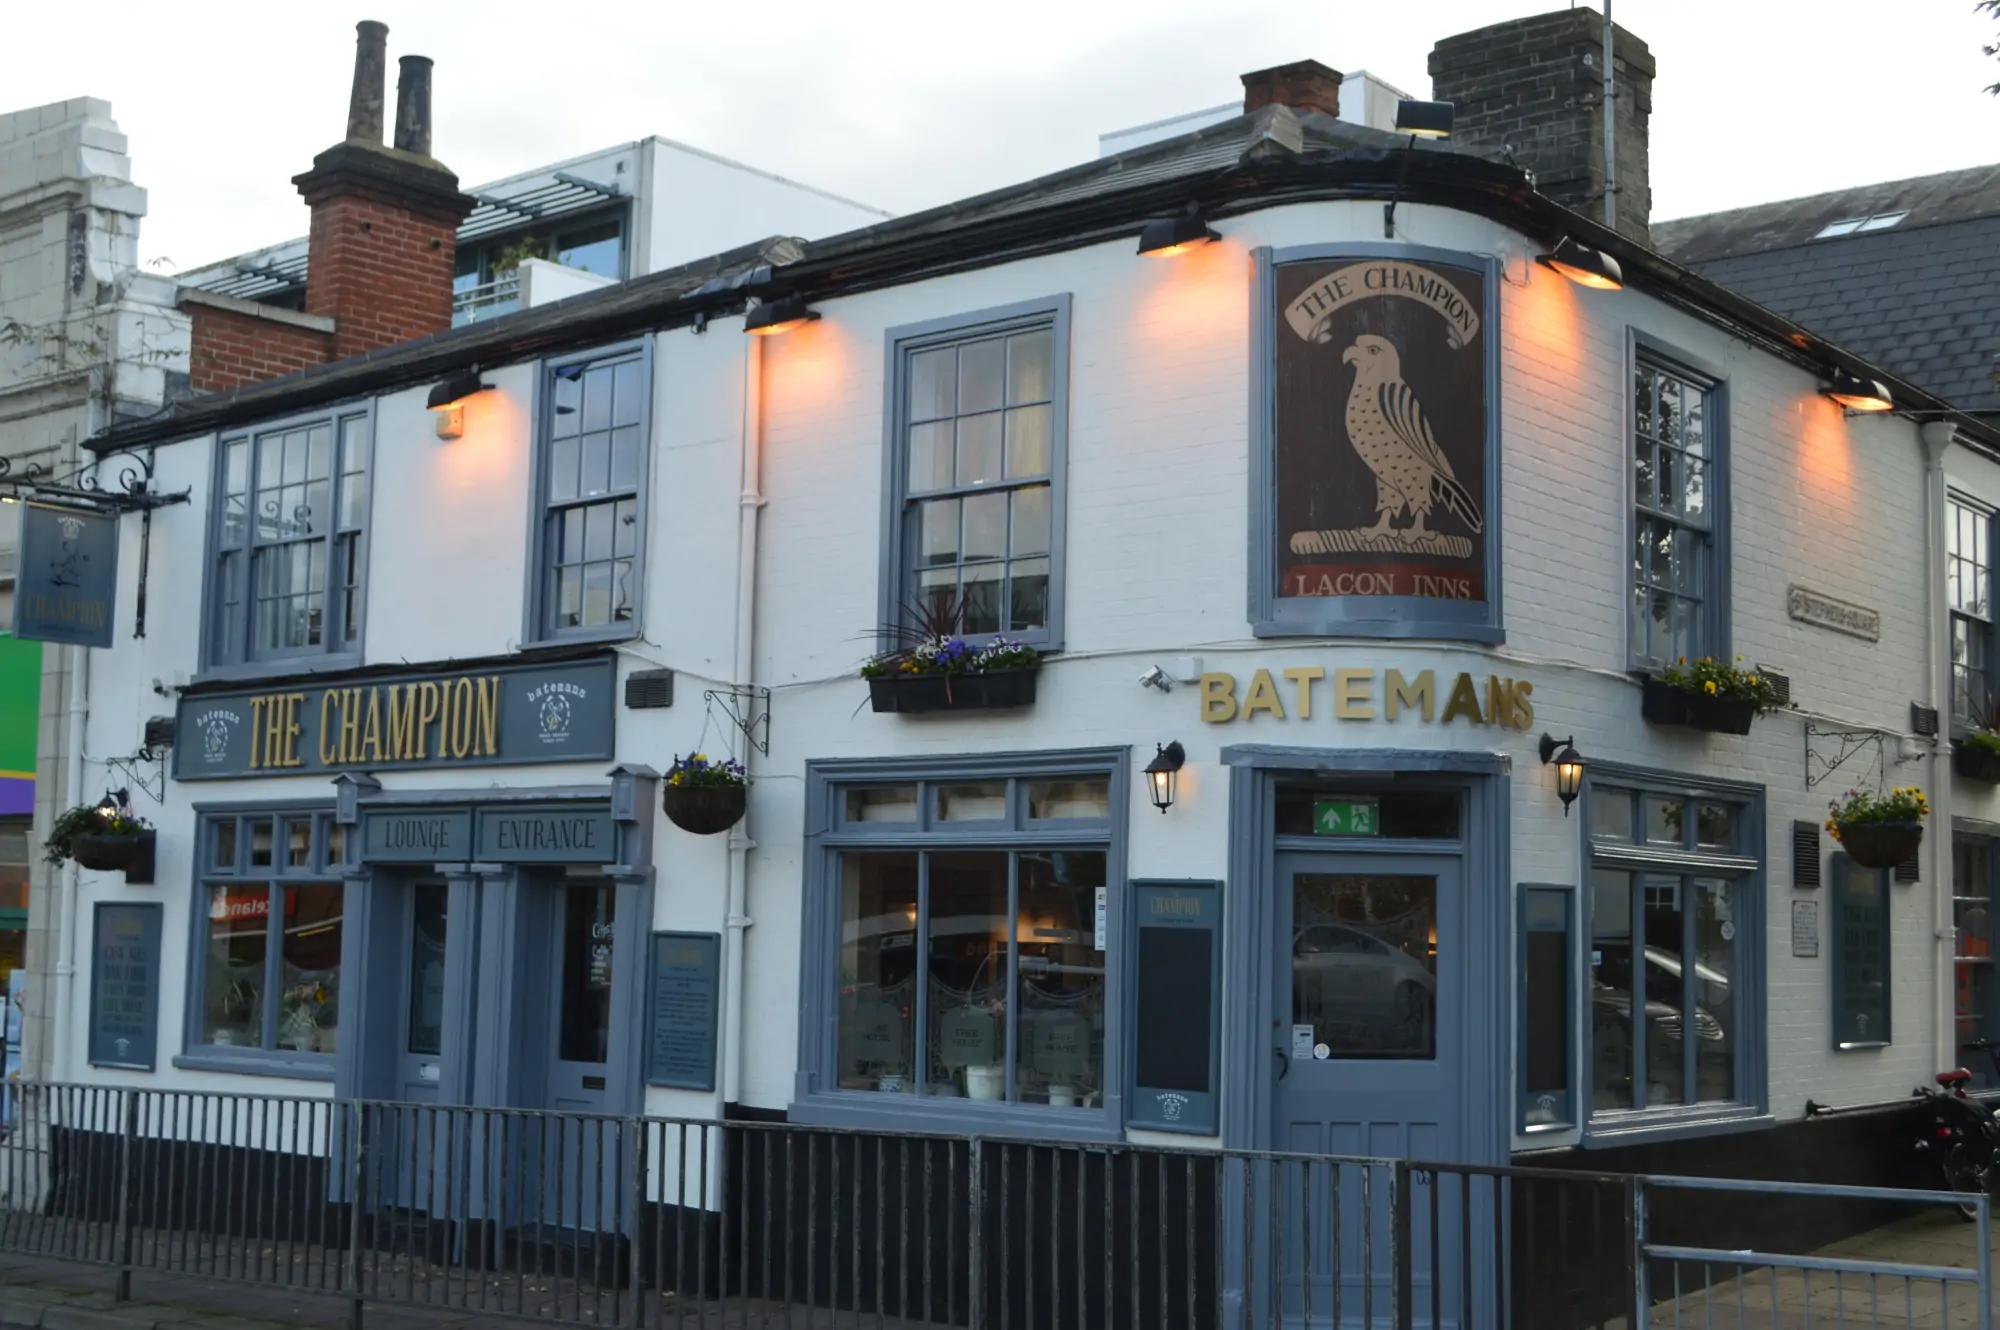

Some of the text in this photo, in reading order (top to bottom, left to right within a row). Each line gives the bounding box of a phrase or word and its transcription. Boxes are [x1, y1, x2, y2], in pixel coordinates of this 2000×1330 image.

[1296, 268, 1476, 333] THE CHAMPION
[1296, 573, 1471, 599] LACON INNS
[526, 682, 586, 702] batemans
[1200, 667, 1534, 732] BATEMANS
[250, 676, 500, 768] THE CHAMPION
[385, 818, 597, 854] LOUNGE ENTRANCE
